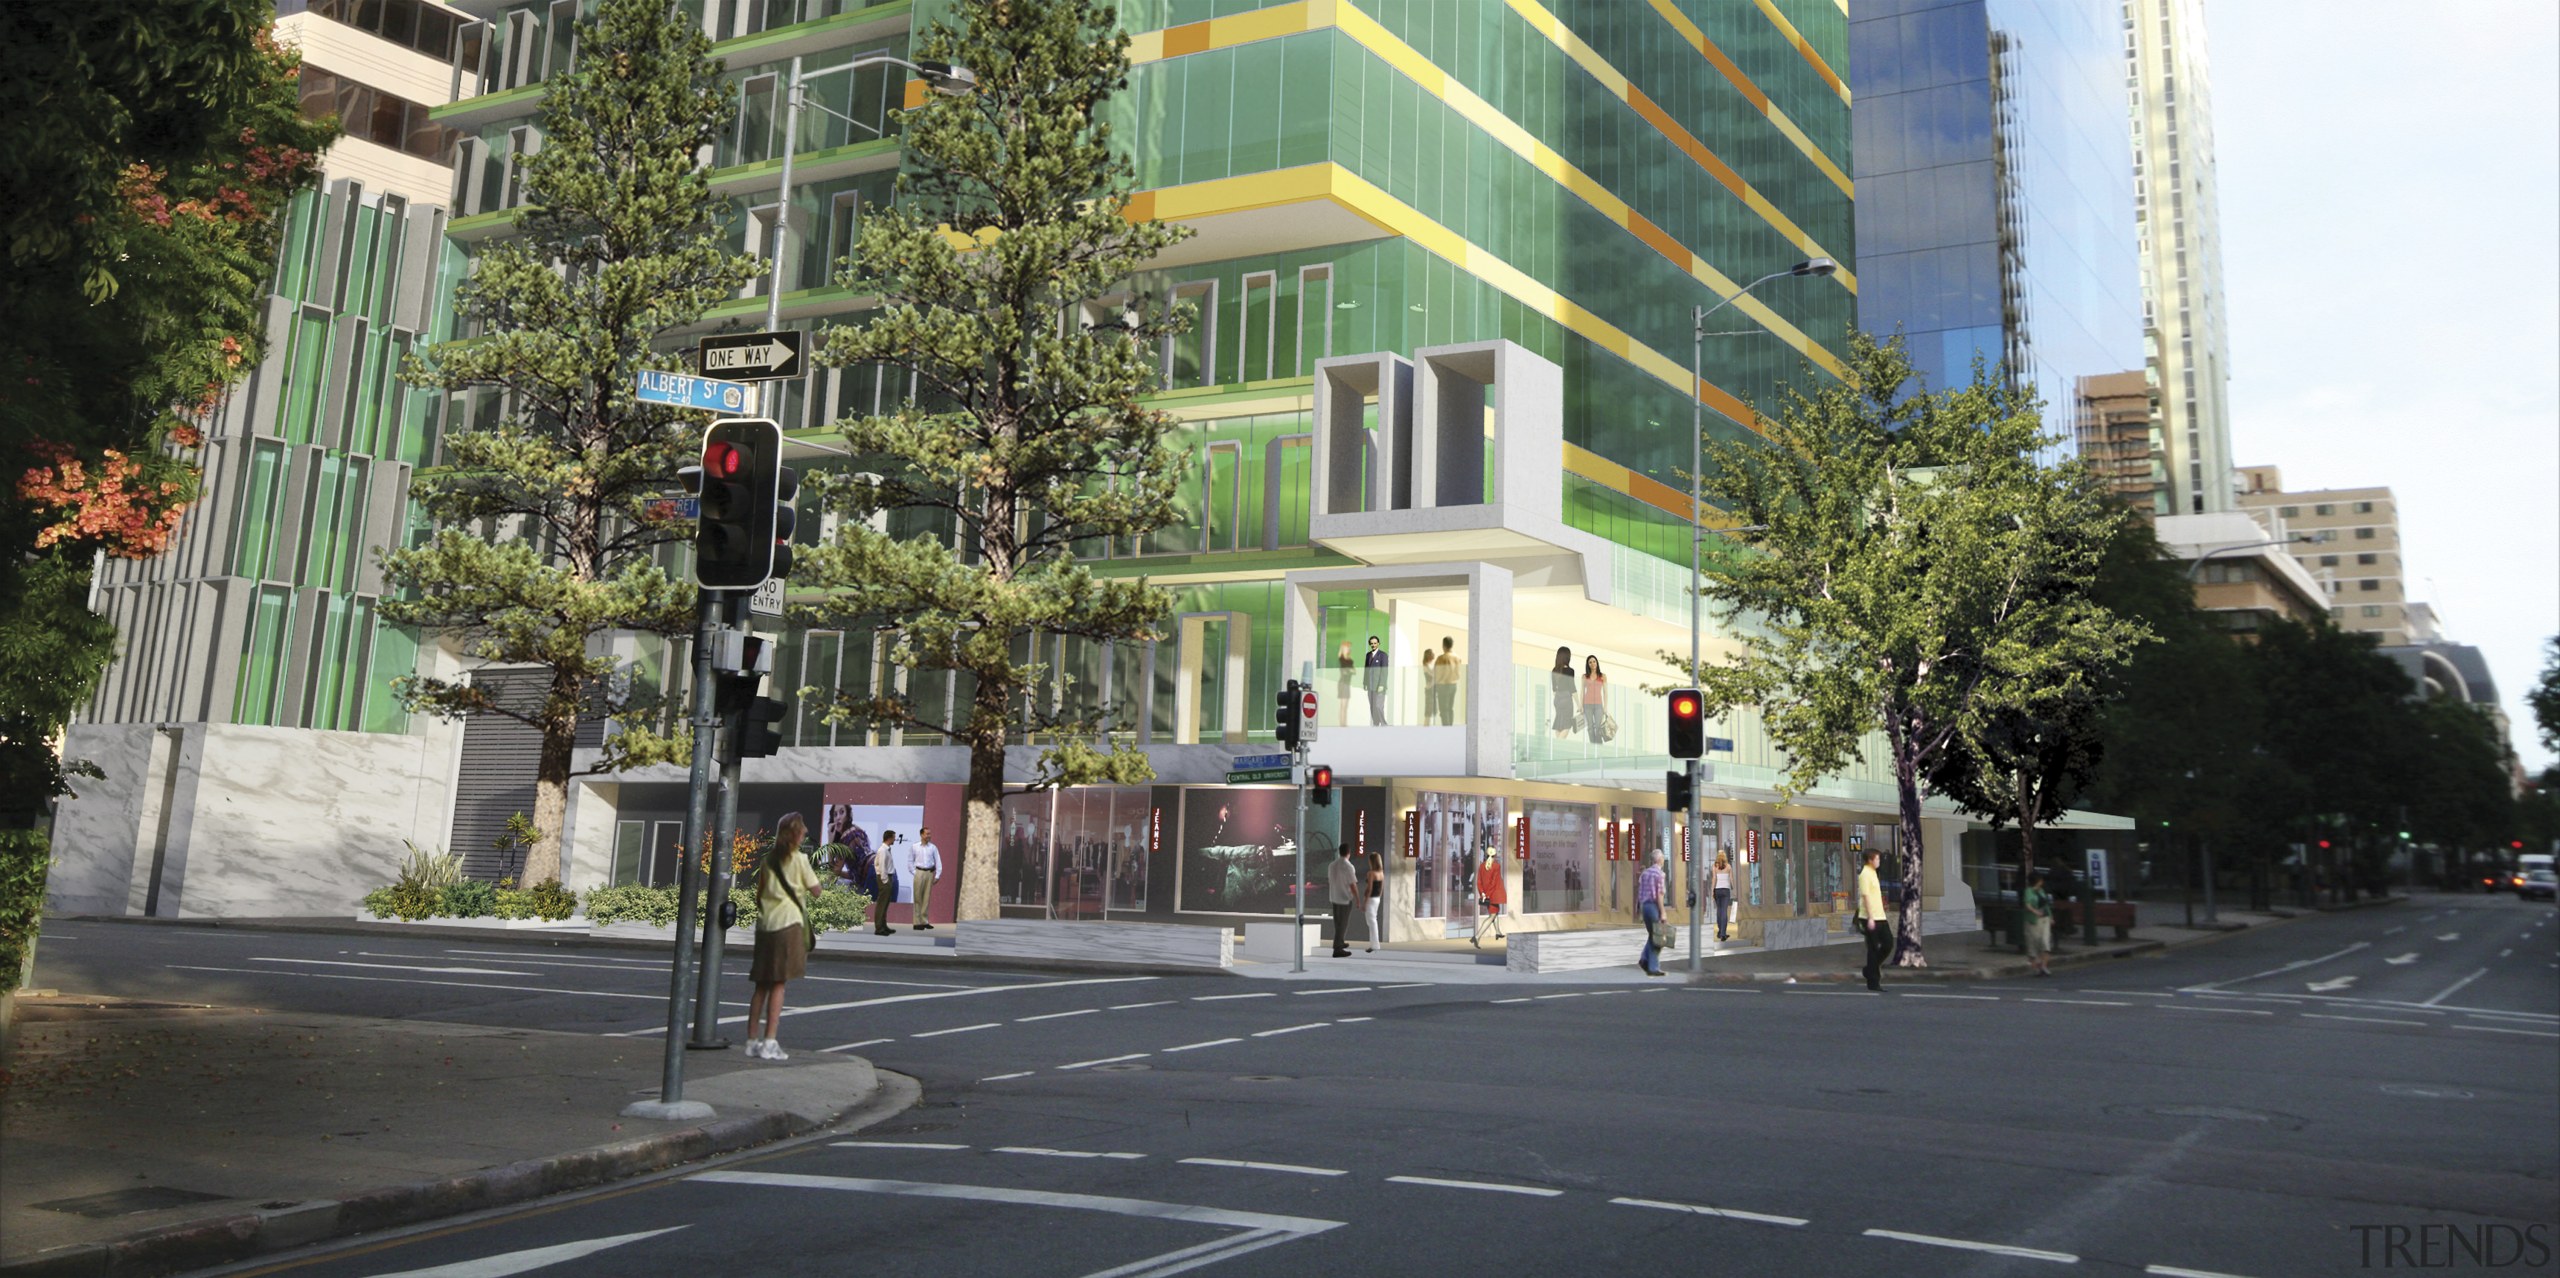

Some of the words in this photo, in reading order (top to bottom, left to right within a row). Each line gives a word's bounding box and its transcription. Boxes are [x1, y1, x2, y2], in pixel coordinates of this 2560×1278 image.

[710, 349, 734, 368] ONE
[745, 346, 770, 365] WAY
[640, 371, 695, 396] ALBERT
[703, 381, 719, 399] ST
[760, 580, 777, 594] NO
[753, 594, 781, 610] ENTRY
[1304, 721, 1313, 729] NO
[1301, 730, 1316, 738] ENTRY
[1771, 833, 1783, 848] N
[1850, 837, 1861, 851] N
